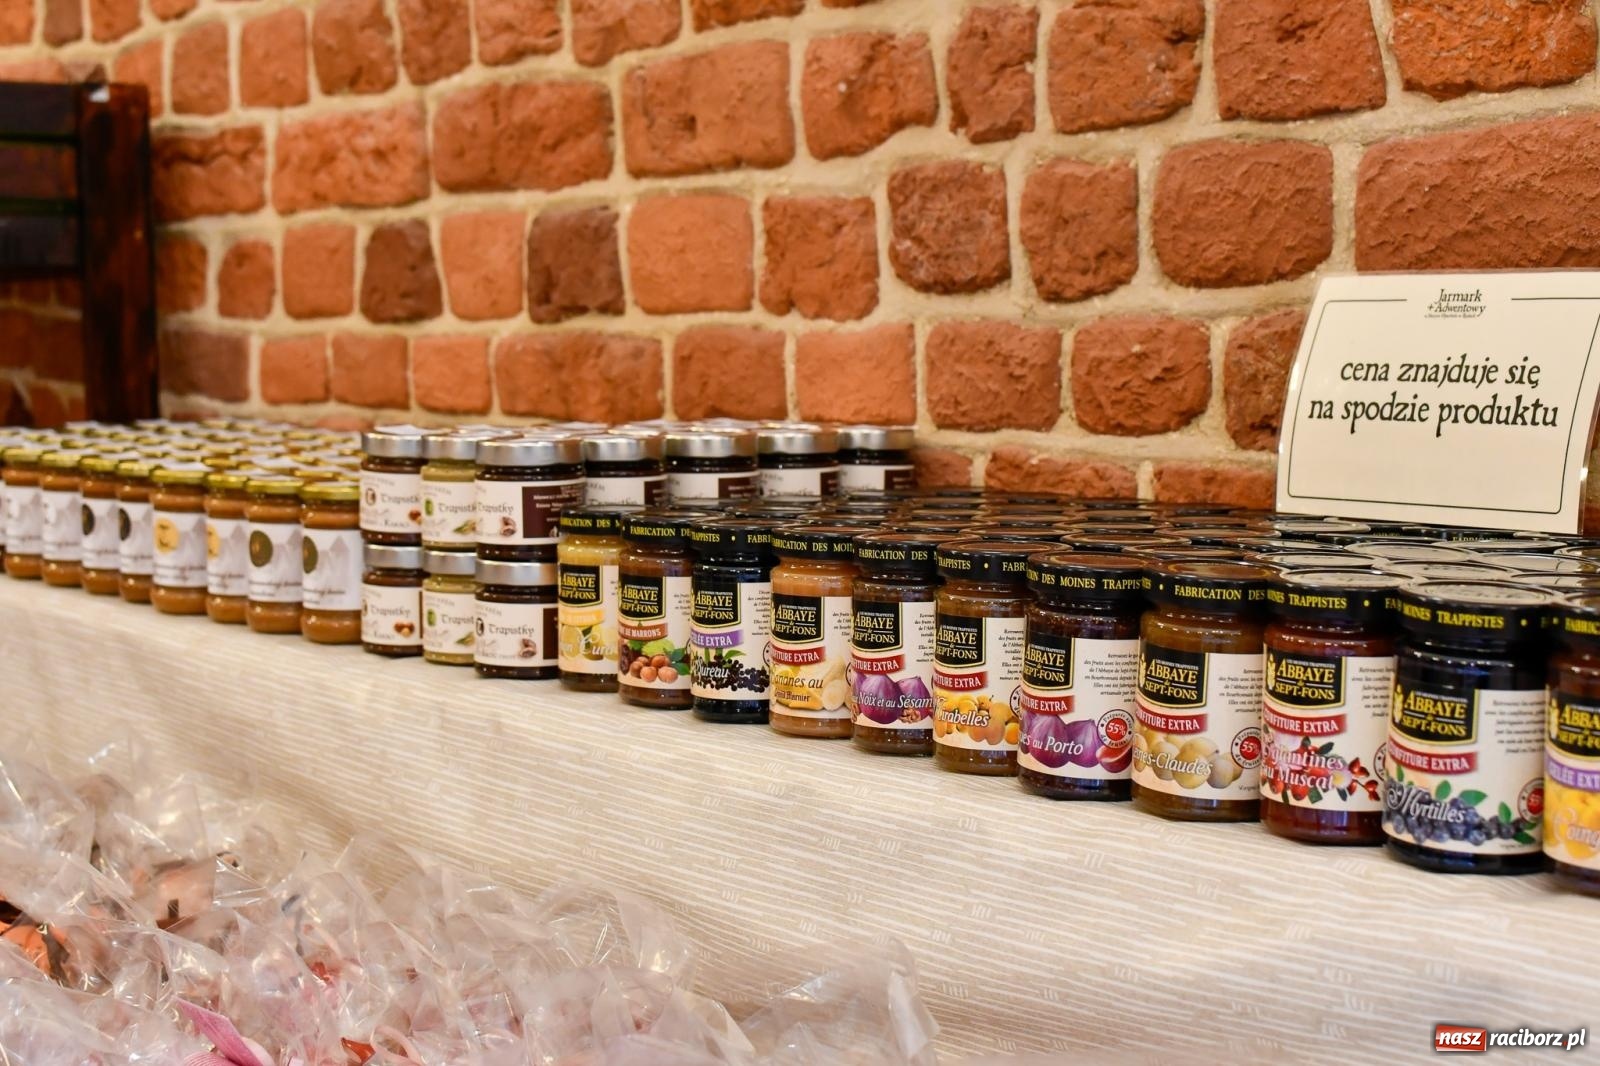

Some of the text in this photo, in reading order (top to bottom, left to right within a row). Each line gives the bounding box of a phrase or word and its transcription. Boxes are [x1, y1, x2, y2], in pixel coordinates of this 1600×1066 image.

[1434, 288, 1482, 304] Jarmark
[1340, 353, 1542, 389] cena znajduje się
[1308, 390, 1560, 438] na spodzie produktu
[596, 519, 611, 528] DES
[630, 525, 676, 537] FABRICATION
[812, 542, 828, 552] DES
[859, 548, 928, 560] FABRICATION DES
[562, 573, 596, 588] ABBAYE
[1041, 573, 1055, 585] DES
[1060, 576, 1096, 589] MOINES
[622, 584, 658, 601] ABBAYE
[695, 591, 733, 607] ABBAYE
[1174, 584, 1242, 600] FABRICATION
[1288, 593, 1348, 609] TRAPPISTES
[776, 604, 817, 622] ABBAYE
[855, 611, 894, 630] ABBAYE
[1436, 610, 1505, 629] TRAPPISTES
[705, 635, 733, 647] EXTRA
[937, 625, 977, 645] ABBAYE
[793, 651, 820, 663] EXTRA
[1025, 643, 1065, 667] ABBAYE
[872, 659, 899, 672] EXTRA
[1147, 659, 1198, 684] ABBAYE
[1277, 658, 1335, 683] ABBAYE
[808, 678, 824, 688] au
[954, 676, 982, 688] EXTRA
[1145, 681, 1198, 700] SEPT-FONS
[1275, 682, 1336, 700] SEPT-FONS
[859, 691, 876, 707] Noix
[877, 696, 884, 707] et
[885, 700, 896, 708] au
[1040, 700, 1068, 712] EXTRA
[1404, 690, 1468, 719] ABBAYE
[1106, 722, 1126, 736] 55%
[1168, 718, 1200, 731] EXTRA
[1303, 719, 1339, 733] EXTRA
[1401, 715, 1468, 737] SEPT-FONS
[1032, 740, 1043, 750] au
[1045, 735, 1084, 755] Porto
[1431, 756, 1470, 771] EXTRA
[1387, 784, 1466, 823] Myrtilles
